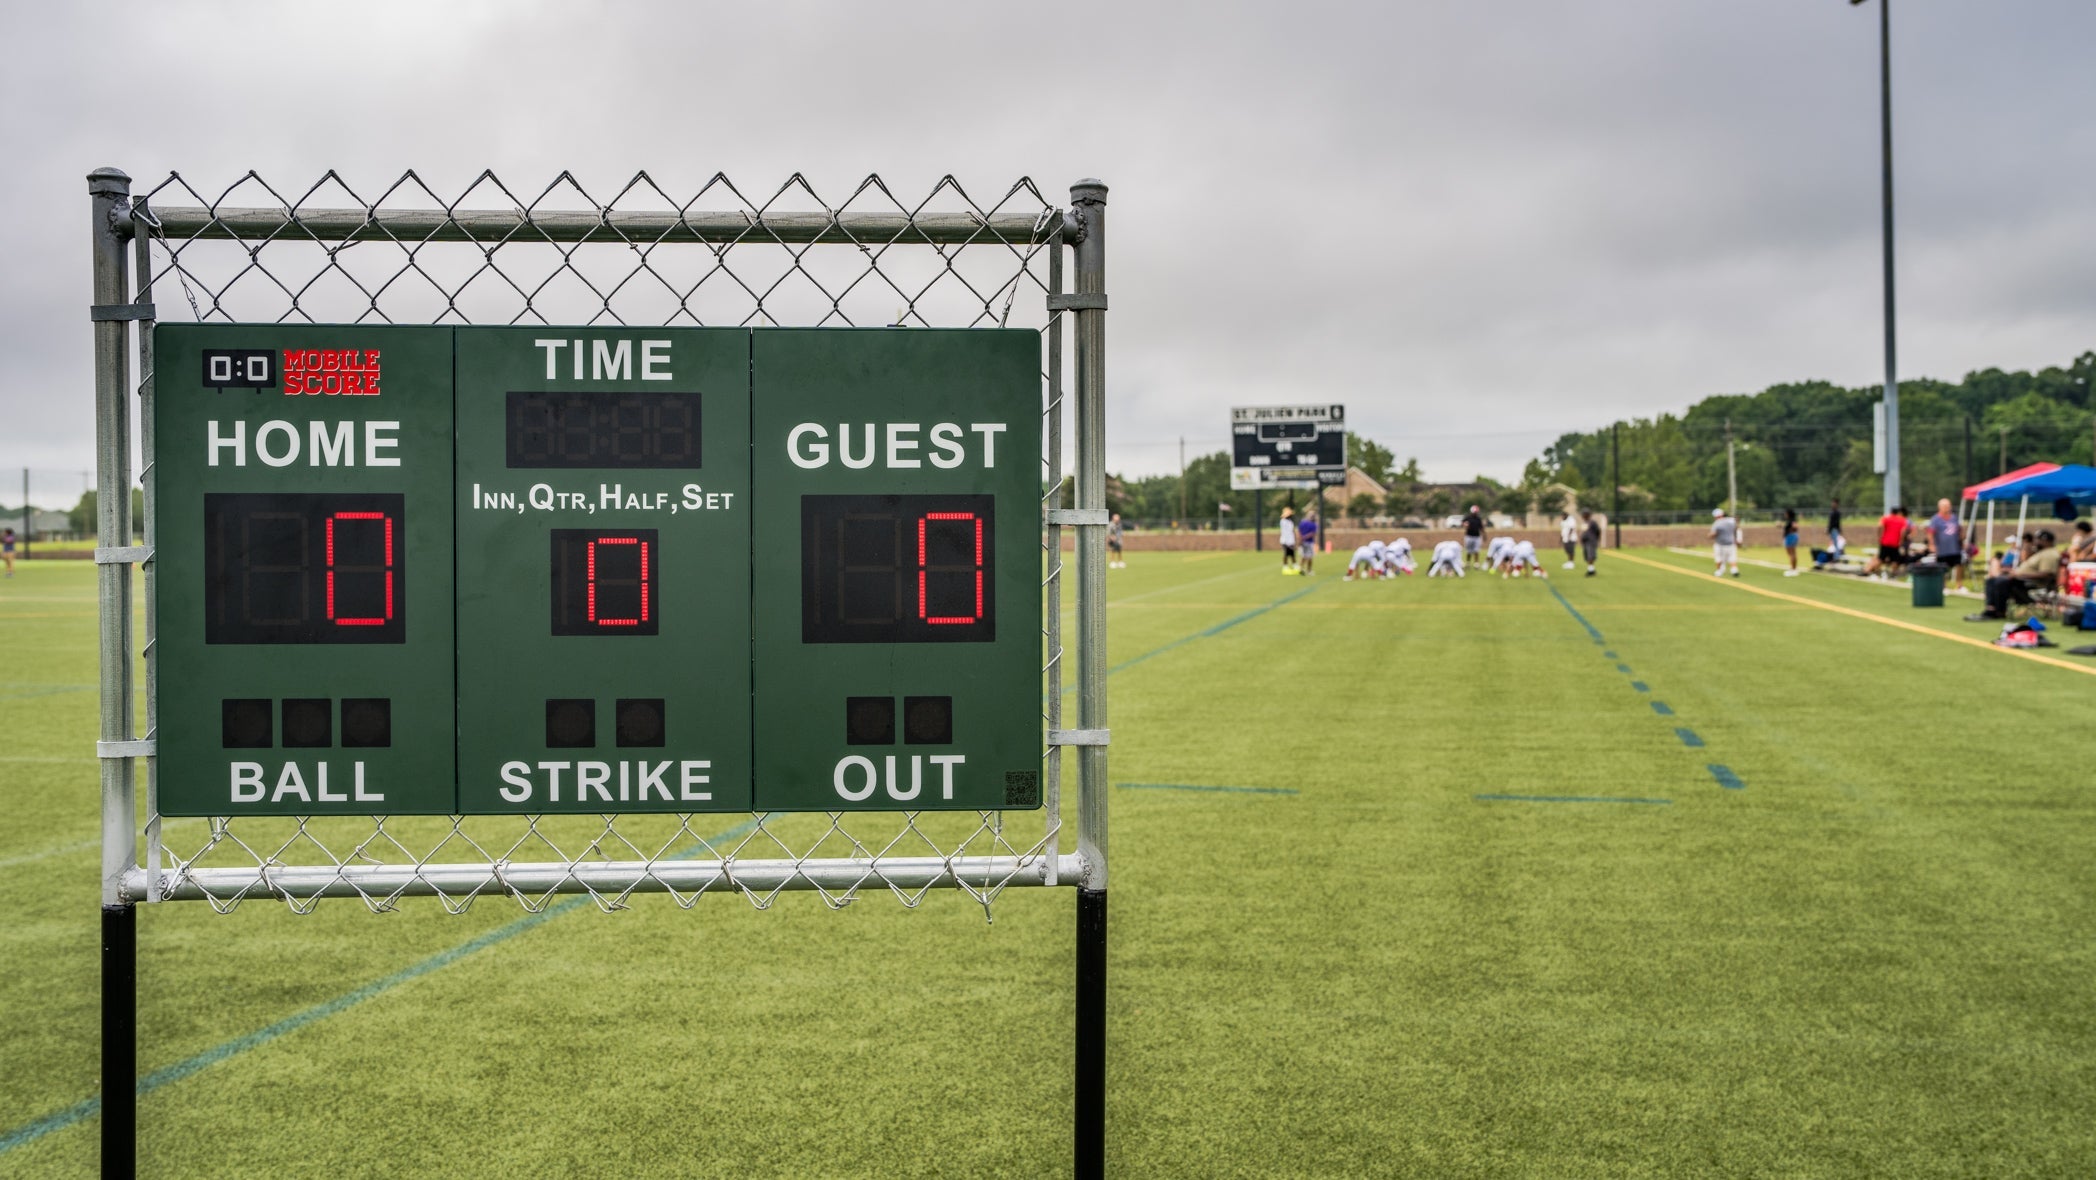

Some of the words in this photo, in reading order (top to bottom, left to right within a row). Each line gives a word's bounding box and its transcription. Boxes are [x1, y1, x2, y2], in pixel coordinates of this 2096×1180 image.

[283, 350, 381, 372] MOBILE
[534, 338, 673, 381] TIME
[283, 372, 381, 396] SCORE
[1298, 406, 1326, 417] PARK
[207, 419, 402, 468] HOME
[786, 422, 1007, 470] GUEST
[325, 511, 393, 626] 0
[587, 537, 649, 626] 0
[917, 512, 983, 625] 0
[230, 761, 385, 803] BALL
[499, 760, 713, 803] STRIKE
[833, 754, 966, 802] OUT
